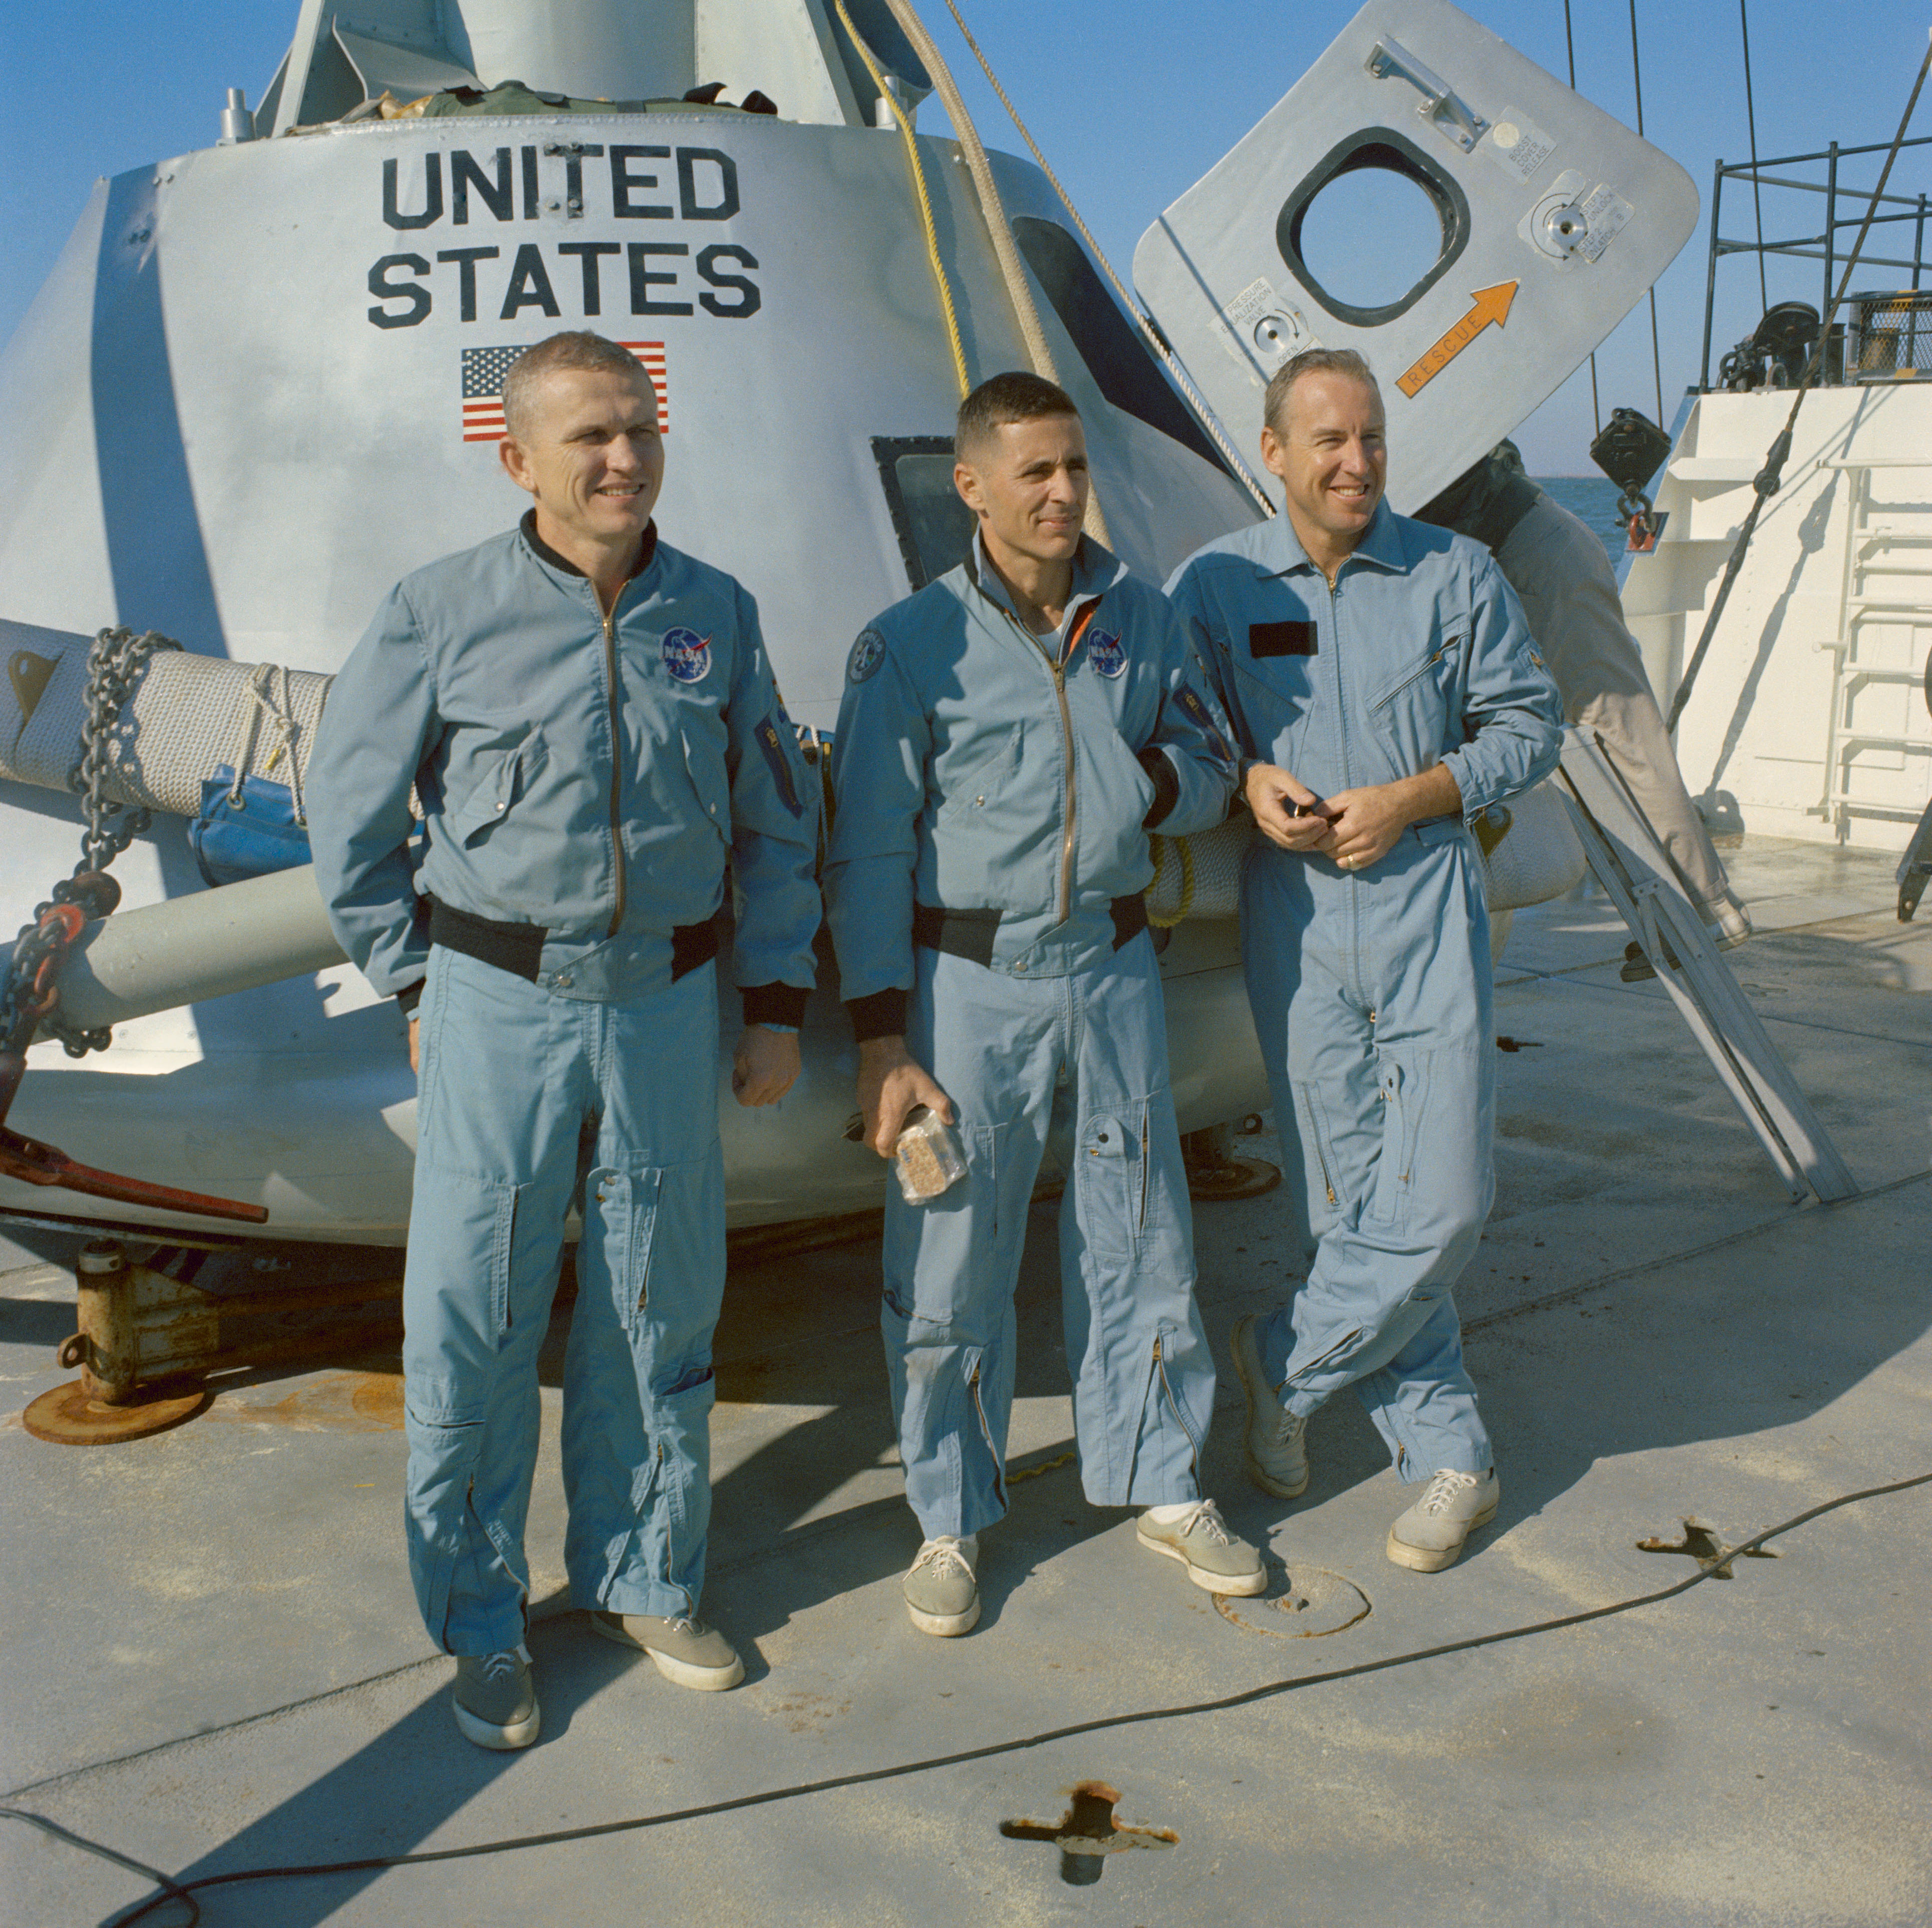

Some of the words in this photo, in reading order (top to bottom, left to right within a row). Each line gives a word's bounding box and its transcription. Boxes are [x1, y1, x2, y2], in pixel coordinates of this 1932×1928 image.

[1509, 135, 1532, 161] BOOST
[1517, 142, 1539, 167] COVER
[1521, 145, 1549, 176] RELEASE
[383, 145, 741, 230] UNITED
[1580, 196, 1596, 215] STEP
[1587, 193, 1615, 221] UNLOCK
[1578, 233, 1595, 253] STEP
[1594, 227, 1602, 236] 2
[1585, 227, 1616, 260] UNLATCH
[368, 243, 761, 330] STATES
[1227, 280, 1266, 315] PRESSURE
[1221, 287, 1272, 334] EQUALIZATION
[1243, 306, 1266, 326] VALVE
[1277, 345, 1299, 365] OPEN
[1407, 315, 1483, 386] RESCUE
[664, 645, 705, 663] NASA
